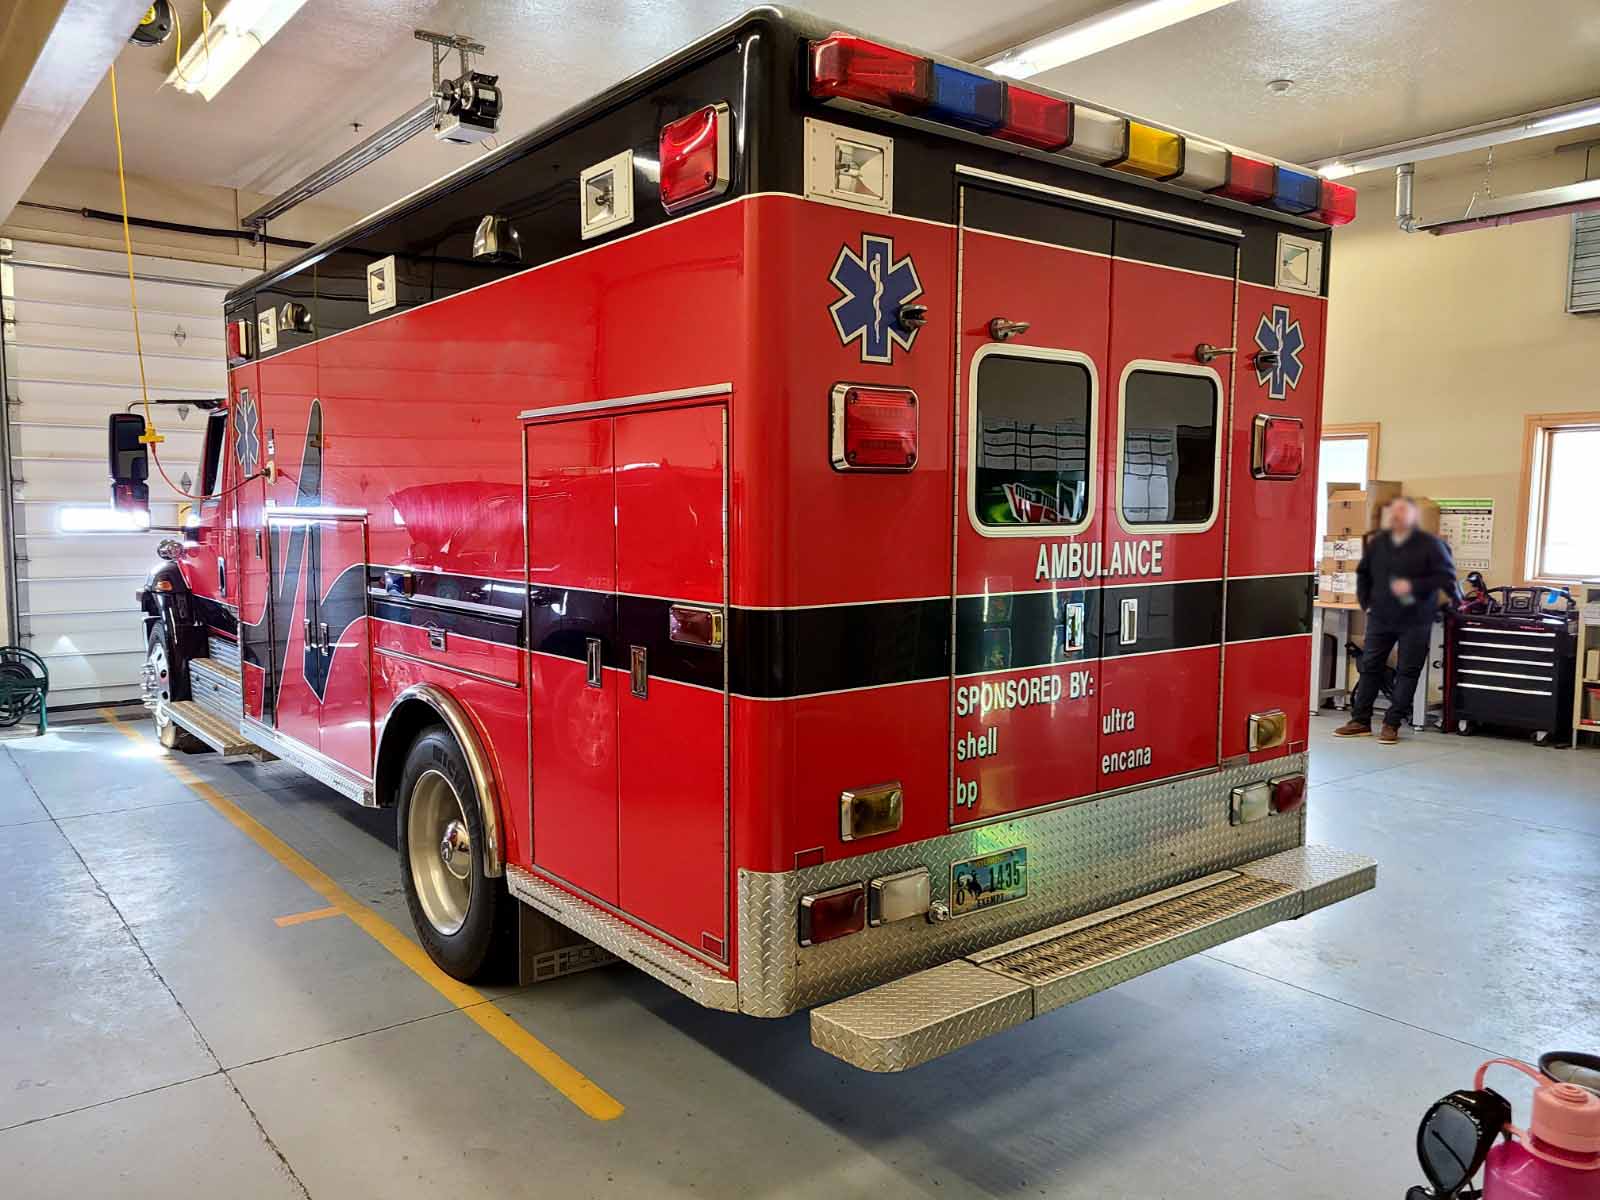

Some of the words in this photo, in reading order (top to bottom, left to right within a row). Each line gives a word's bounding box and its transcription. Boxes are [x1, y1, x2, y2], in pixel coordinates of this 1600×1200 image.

[1035, 540, 1164, 581] AMBULANCE
[956, 674, 1062, 717] SPONSORED
[1069, 671, 1095, 699] BY:
[1102, 707, 1136, 735] ultra
[956, 727, 999, 761] shell
[1101, 745, 1152, 775] encana
[956, 776, 979, 809] bp
[990, 860, 1021, 891] 1435
